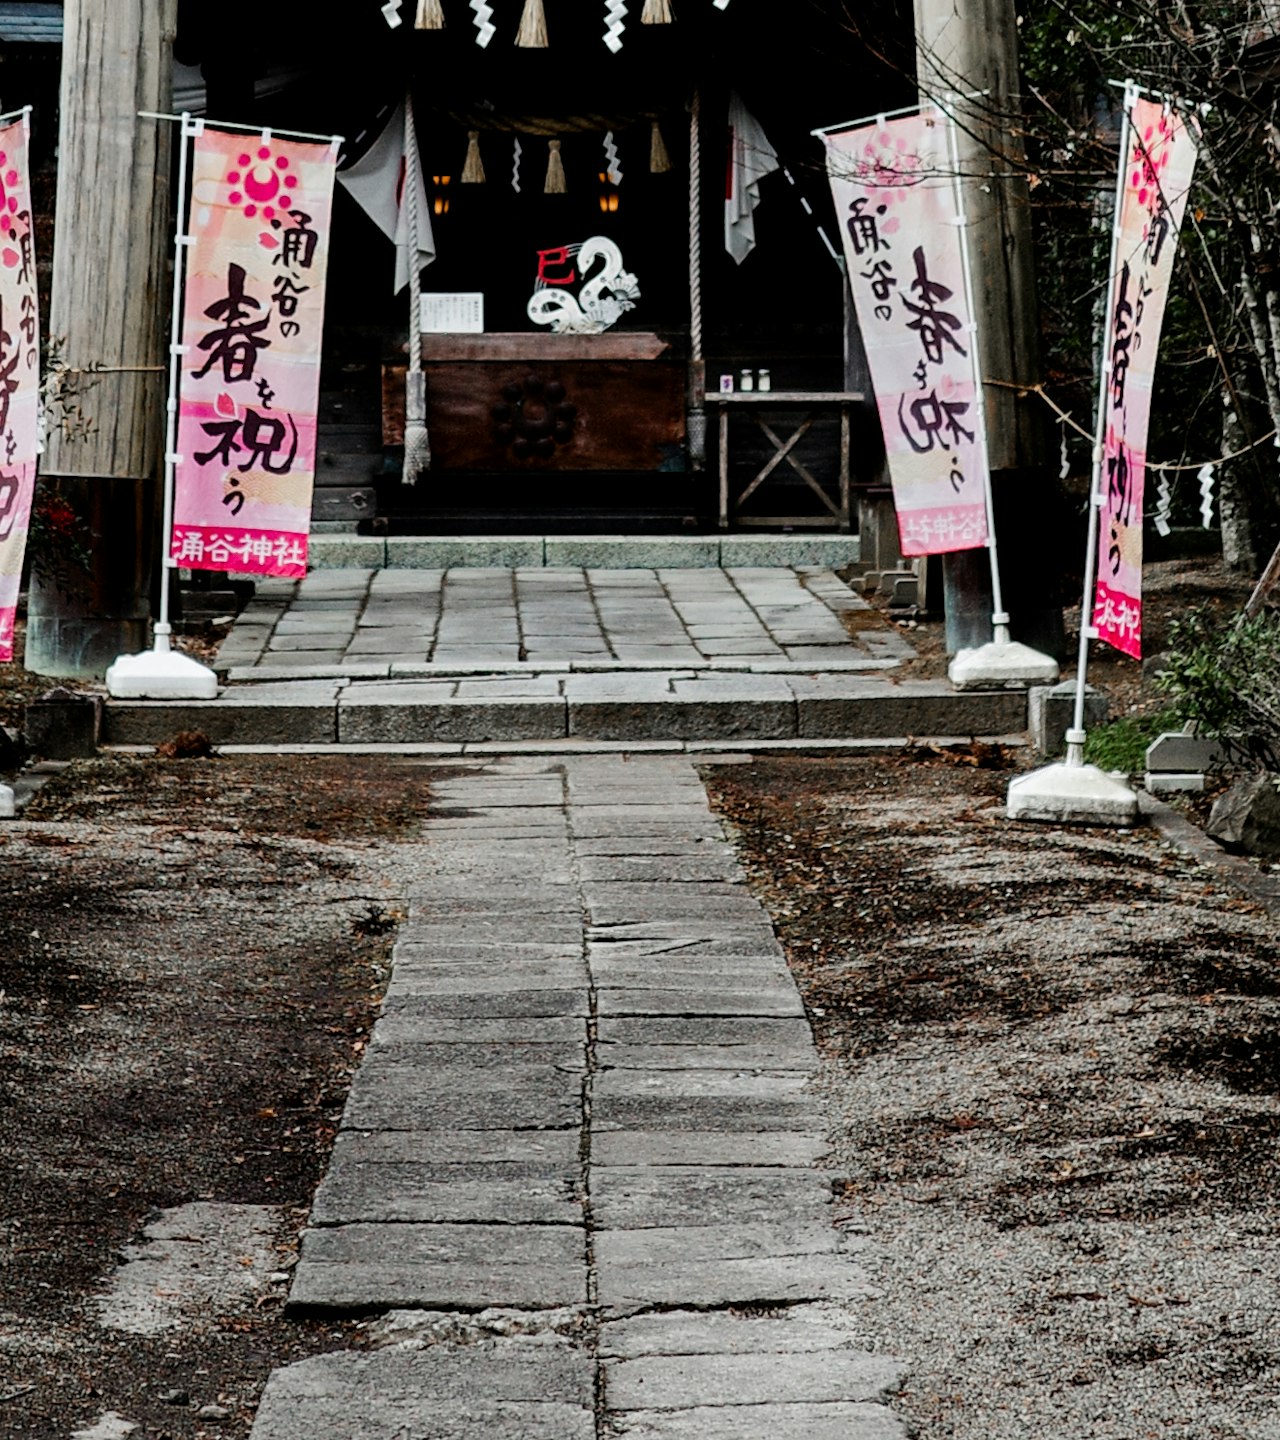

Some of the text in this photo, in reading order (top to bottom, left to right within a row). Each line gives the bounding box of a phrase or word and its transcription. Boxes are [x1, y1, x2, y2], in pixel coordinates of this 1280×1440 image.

[270, 210, 320, 338] 涌谷の
[191, 262, 298, 516] 春を祝う
[173, 529, 305, 567] 涌谷神社
